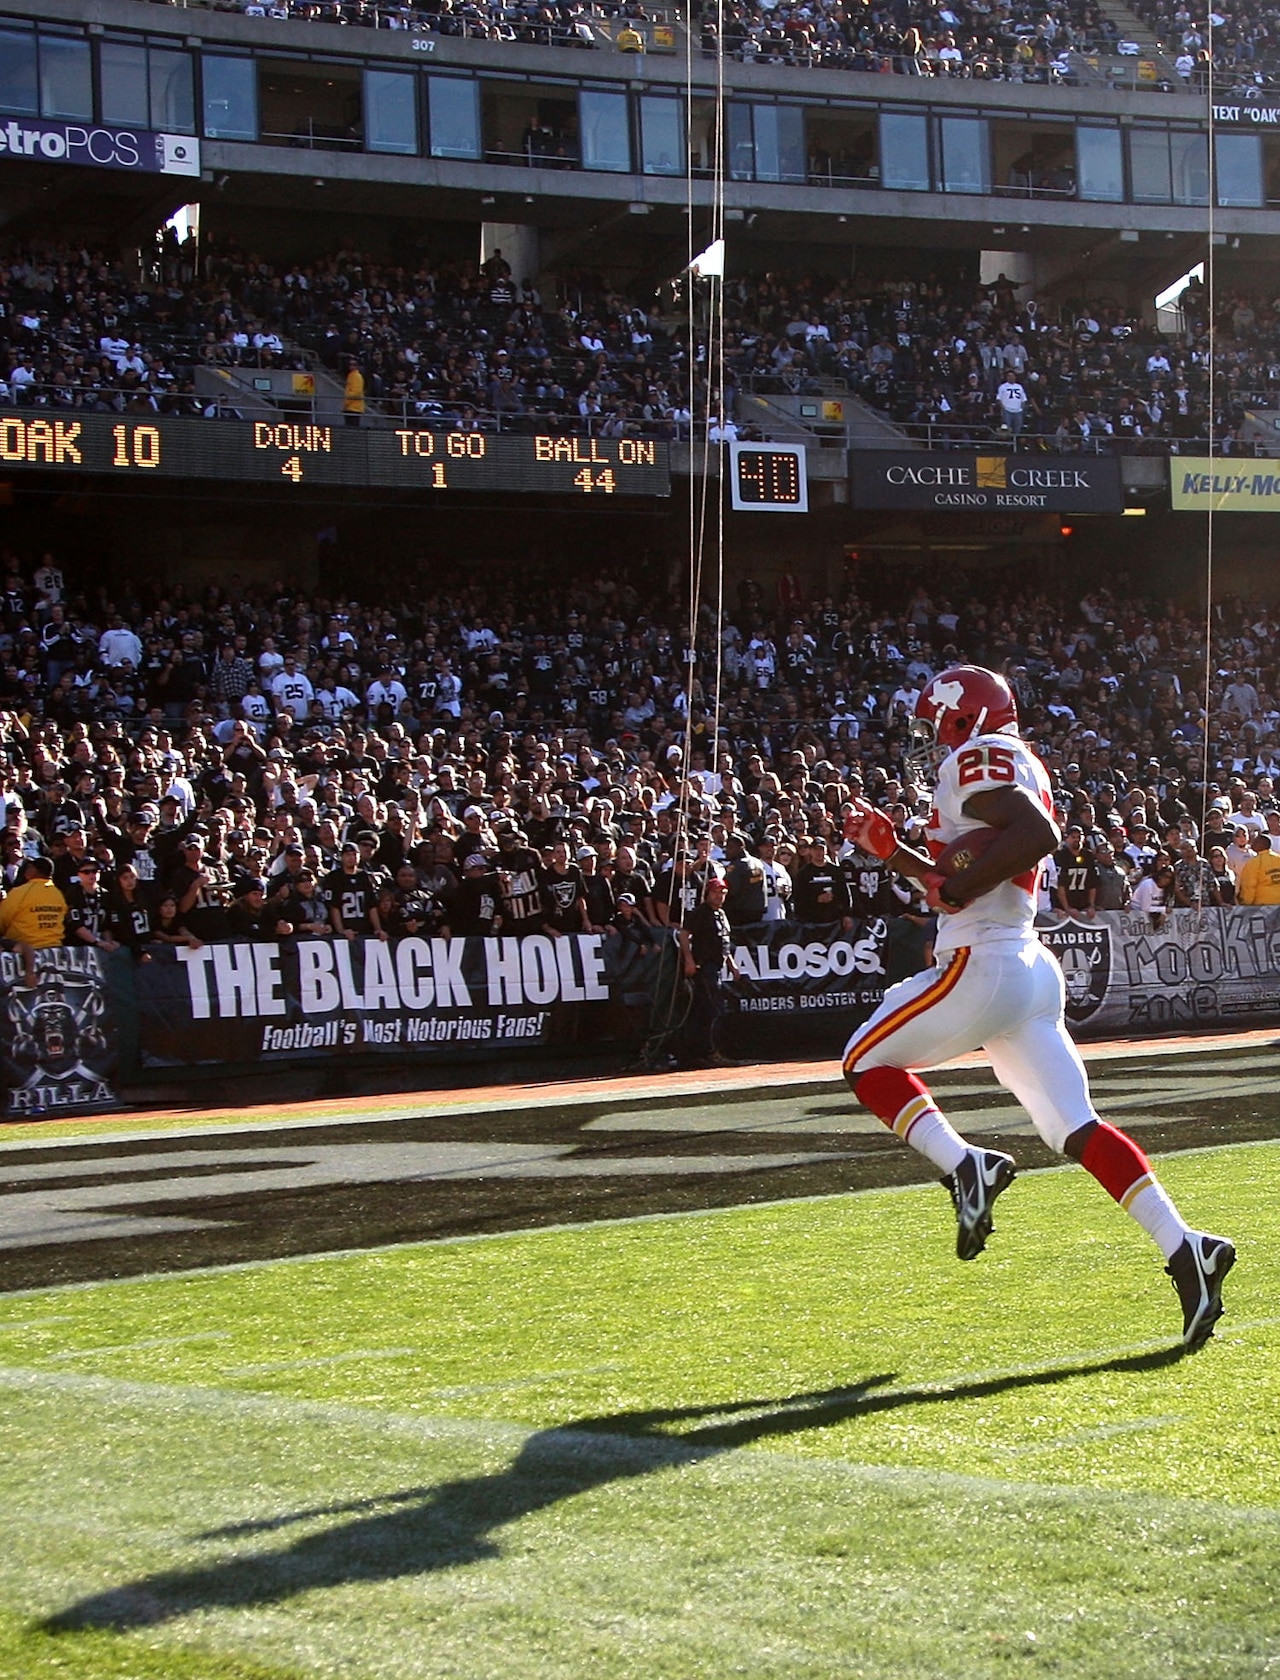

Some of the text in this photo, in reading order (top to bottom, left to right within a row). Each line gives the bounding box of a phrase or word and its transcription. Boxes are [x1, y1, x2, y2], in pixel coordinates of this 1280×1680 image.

[411, 38, 436, 53] 307
[1212, 105, 1240, 121] TEXT
[1006, 387, 1021, 400] 75
[0, 418, 160, 468] OAK 10
[254, 422, 331, 453] DOWN
[395, 430, 485, 459] TO GO
[534, 436, 655, 466] BALL ON
[281, 456, 303, 483] 4
[431, 462, 448, 489] 1
[573, 468, 617, 495] 44
[740, 455, 797, 500] 40
[886, 466, 1091, 489] CACHE CREEK
[934, 493, 1048, 507] CASINO RESORT
[284, 683, 304, 700] 25
[957, 747, 1016, 787] 25
[1067, 867, 1089, 892] 77
[341, 891, 365, 919] 20
[131, 909, 150, 935] 21
[1041, 931, 1103, 946] RAIDERS
[175, 932, 610, 1019] THE BLACK HOLE
[740, 995, 795, 1012] RAIDERS
[800, 991, 857, 1009] BOOSTER
[262, 1020, 356, 1051] Football's
[363, 1019, 402, 1044] Most
[407, 1016, 492, 1043] Notorious
